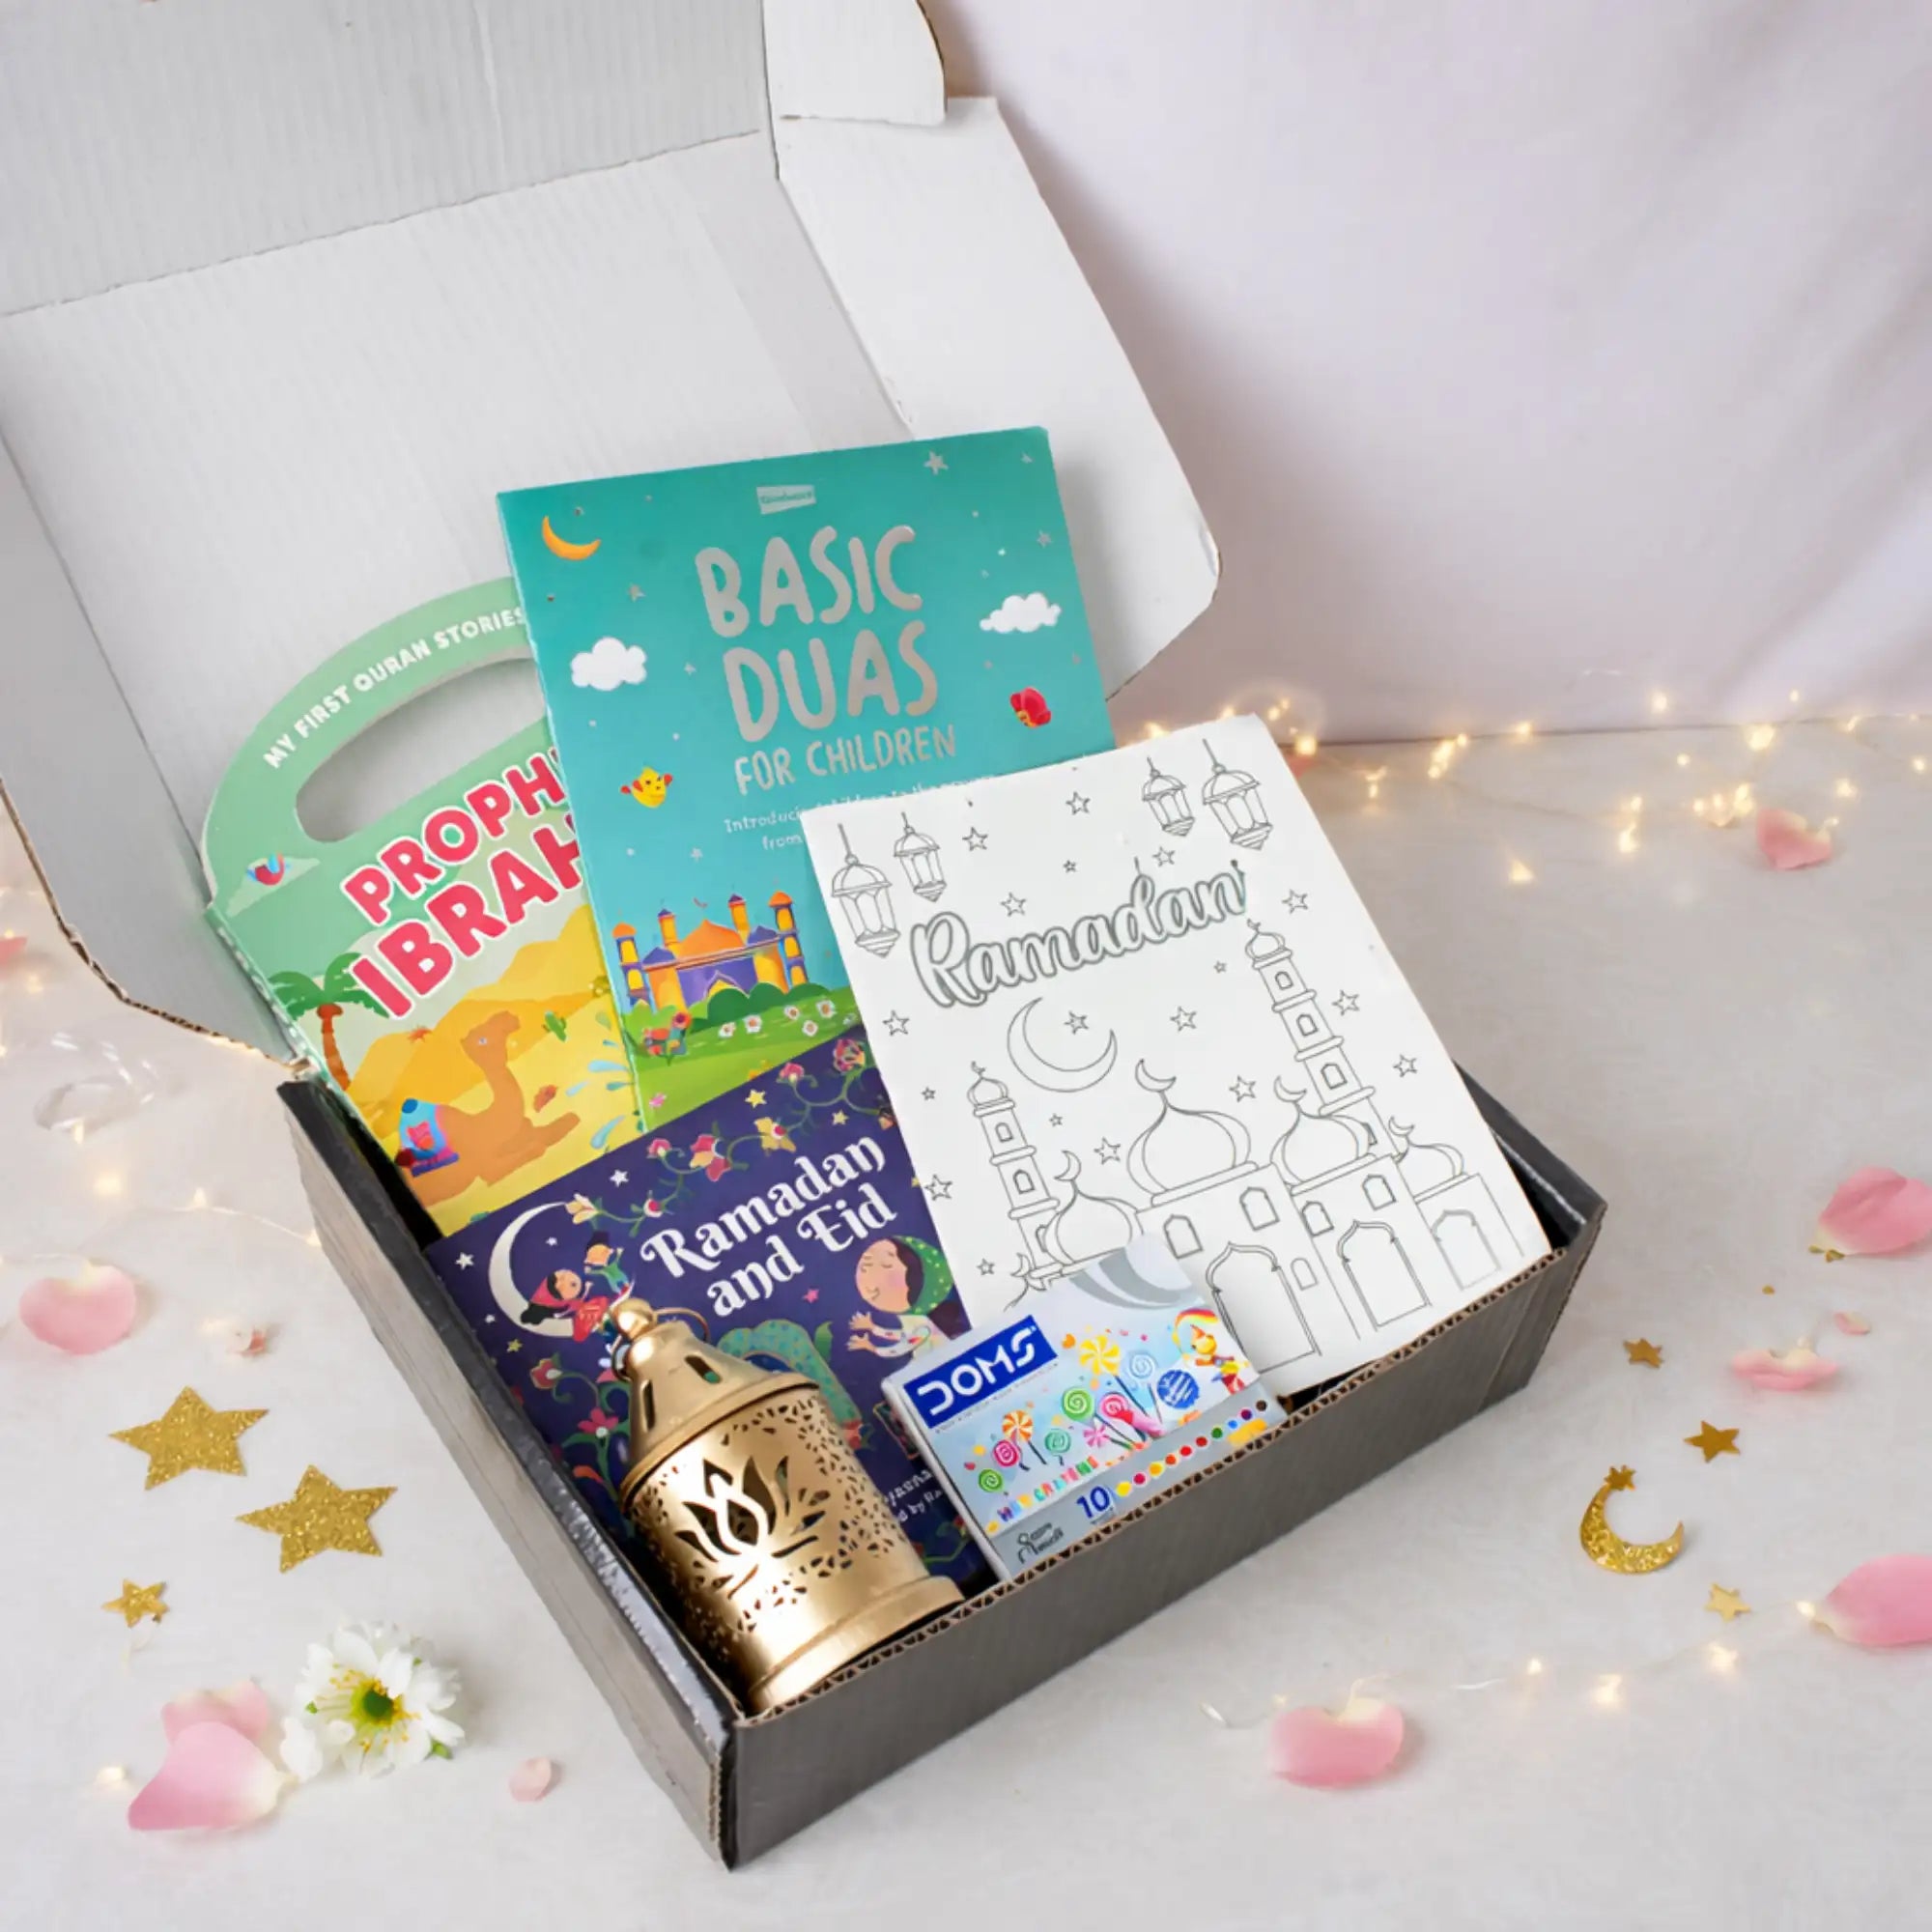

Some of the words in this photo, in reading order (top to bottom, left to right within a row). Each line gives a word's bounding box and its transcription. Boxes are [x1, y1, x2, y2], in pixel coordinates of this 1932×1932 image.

[696, 526, 923, 638] BASIC
[263, 734, 297, 769] MY
[294, 685, 352, 739] FIRST
[433, 606, 526, 649] STORIES
[724, 620, 938, 742] DUAS
[724, 805, 801, 833] Introduci
[734, 748, 796, 796] FOR
[806, 724, 956, 776] CHILDREN
[343, 748, 565, 925] PROPH
[910, 869, 1246, 1008] Ramadan
[639, 1137, 886, 1278] Ramadan
[707, 1235, 805, 1317] and
[796, 1182, 897, 1252] Eid
[918, 1326, 1037, 1416] DOMS
[1076, 1486, 1110, 1519] 10
